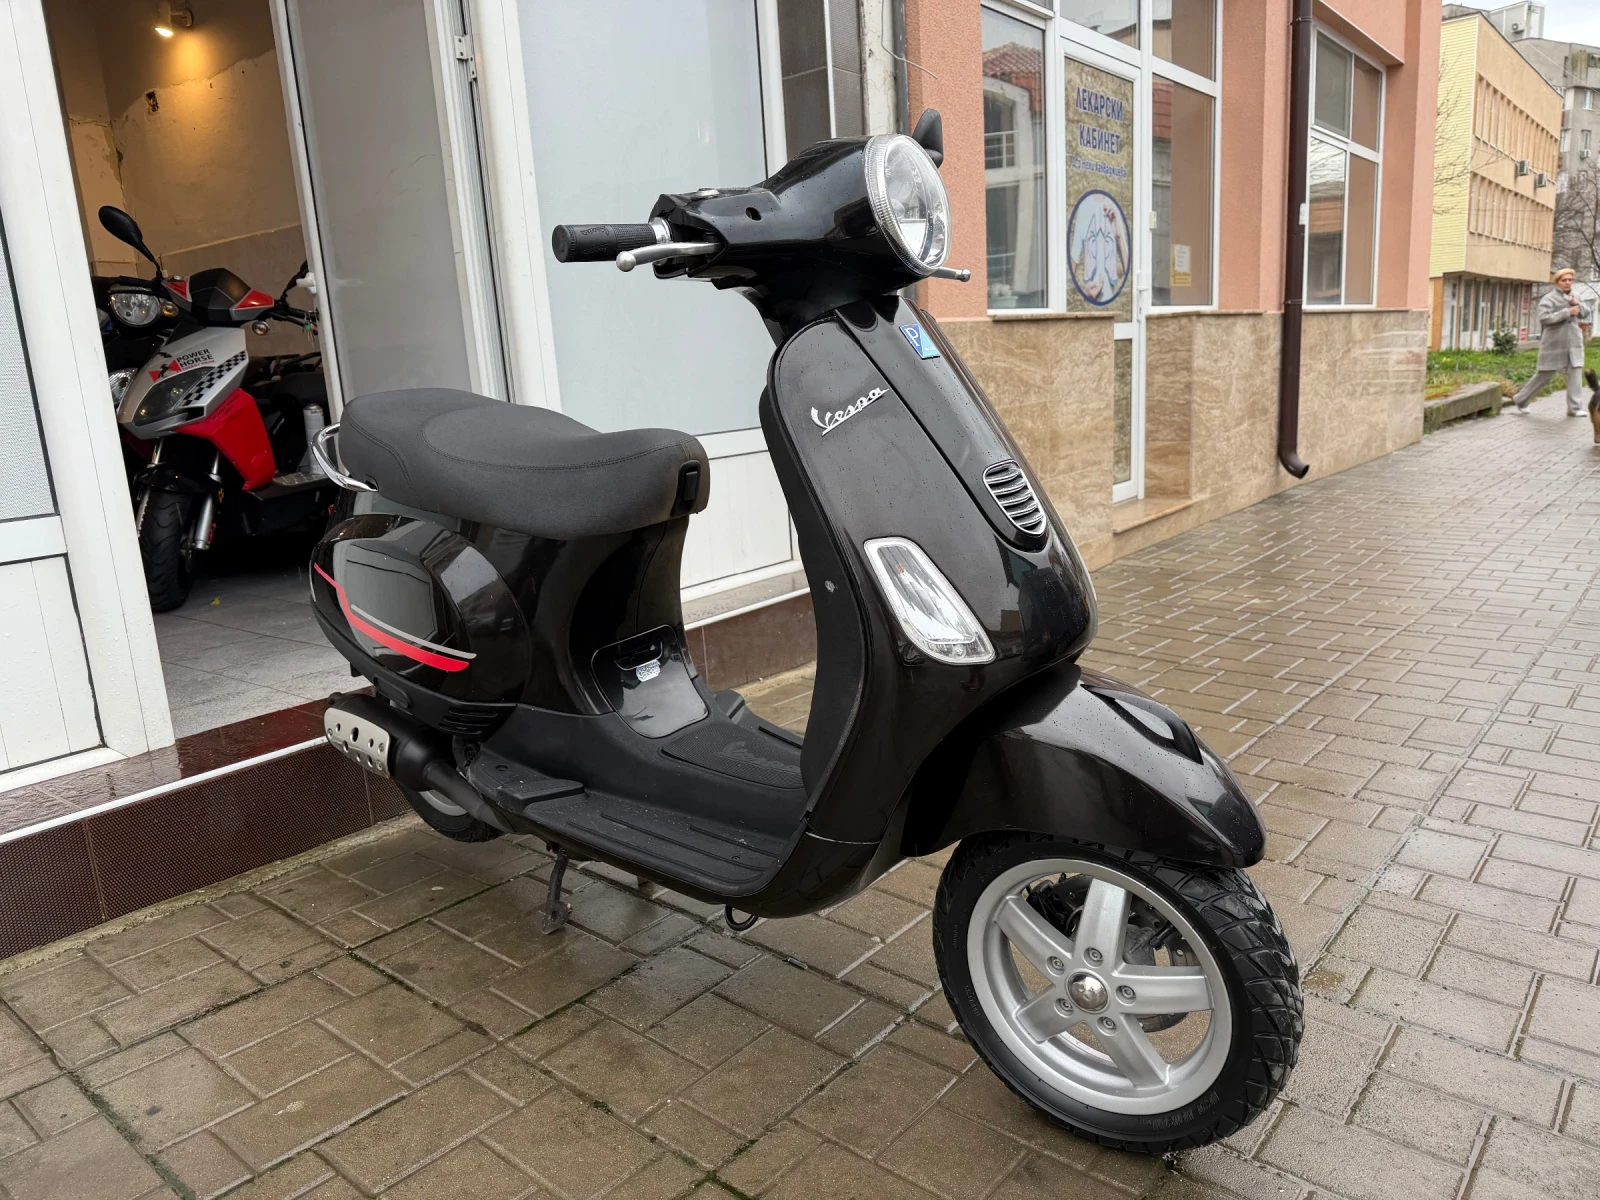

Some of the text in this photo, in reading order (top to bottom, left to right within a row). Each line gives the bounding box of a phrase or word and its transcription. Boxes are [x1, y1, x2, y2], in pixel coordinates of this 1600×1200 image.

[1075, 86, 1123, 122] ЛЕКАРСКИ
[1079, 123, 1121, 155] КАБИНЕТ
[176, 349, 210, 362] POWER
[179, 354, 214, 367] HORSE
[811, 387, 889, 437] Vespa
